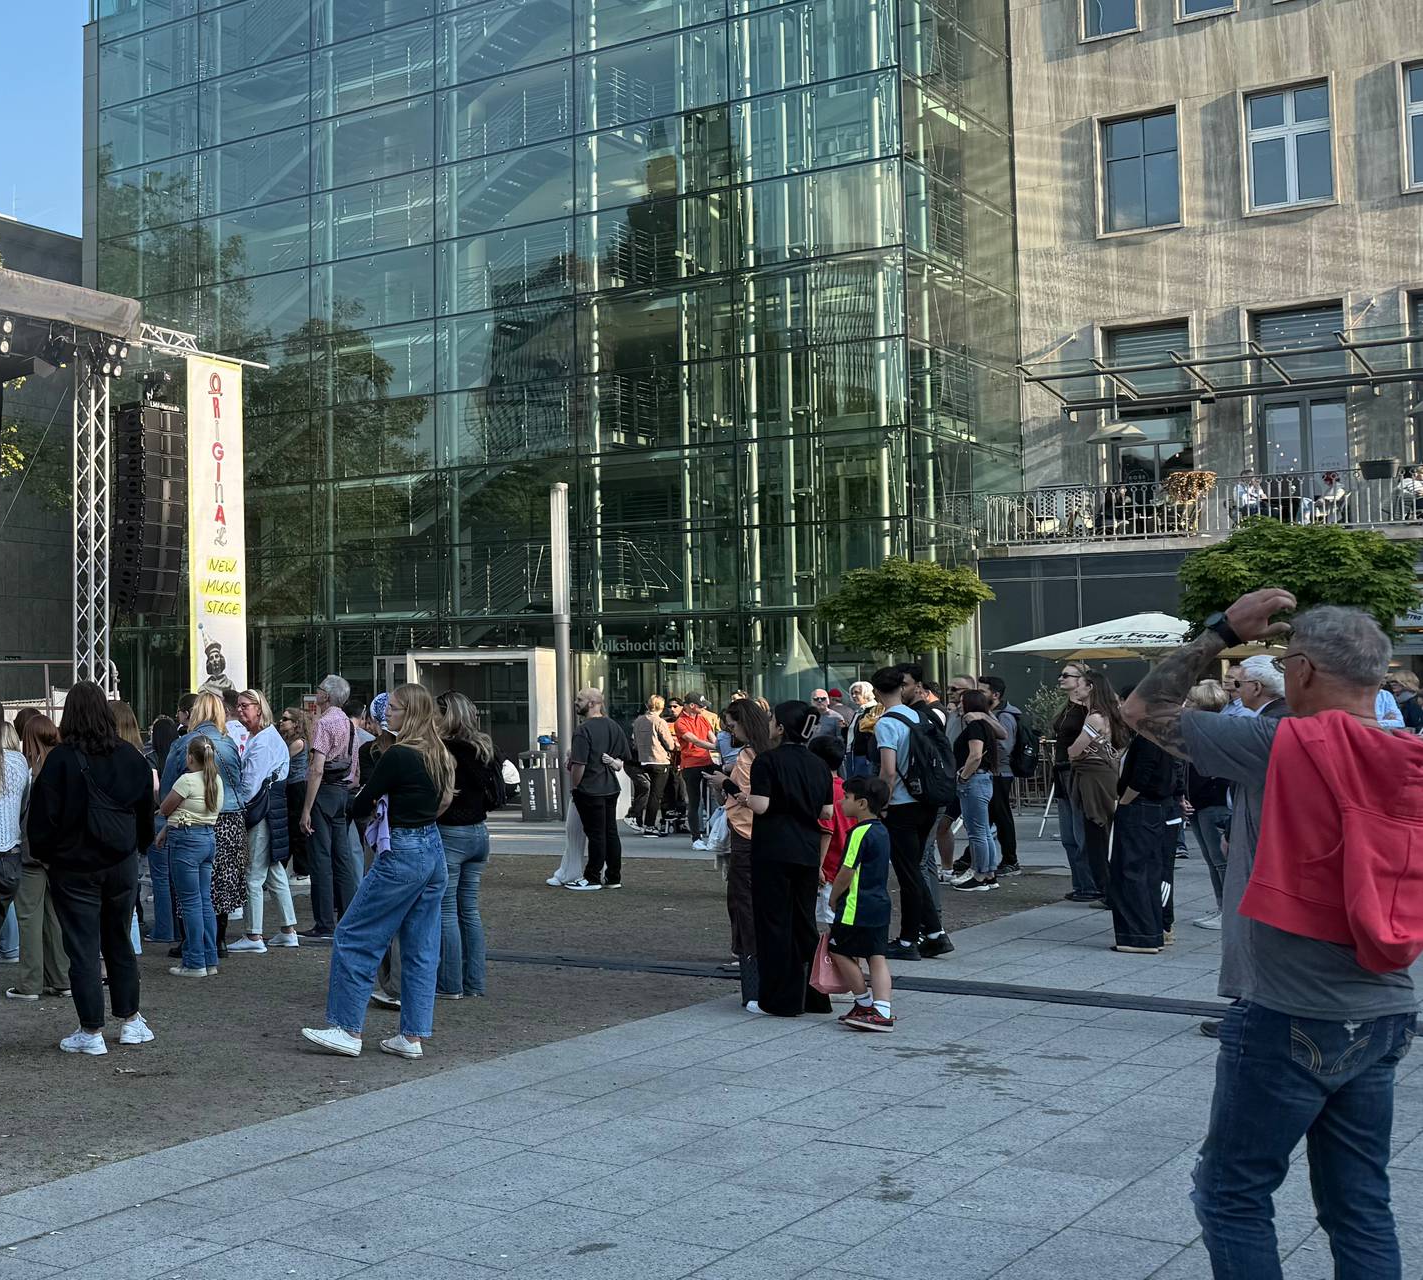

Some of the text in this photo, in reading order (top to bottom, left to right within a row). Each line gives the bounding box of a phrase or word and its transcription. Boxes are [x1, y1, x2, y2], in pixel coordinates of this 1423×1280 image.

[209, 558, 237, 572] NEW
[206, 579, 240, 594] MUSIC
[207, 600, 240, 615] STAGE
